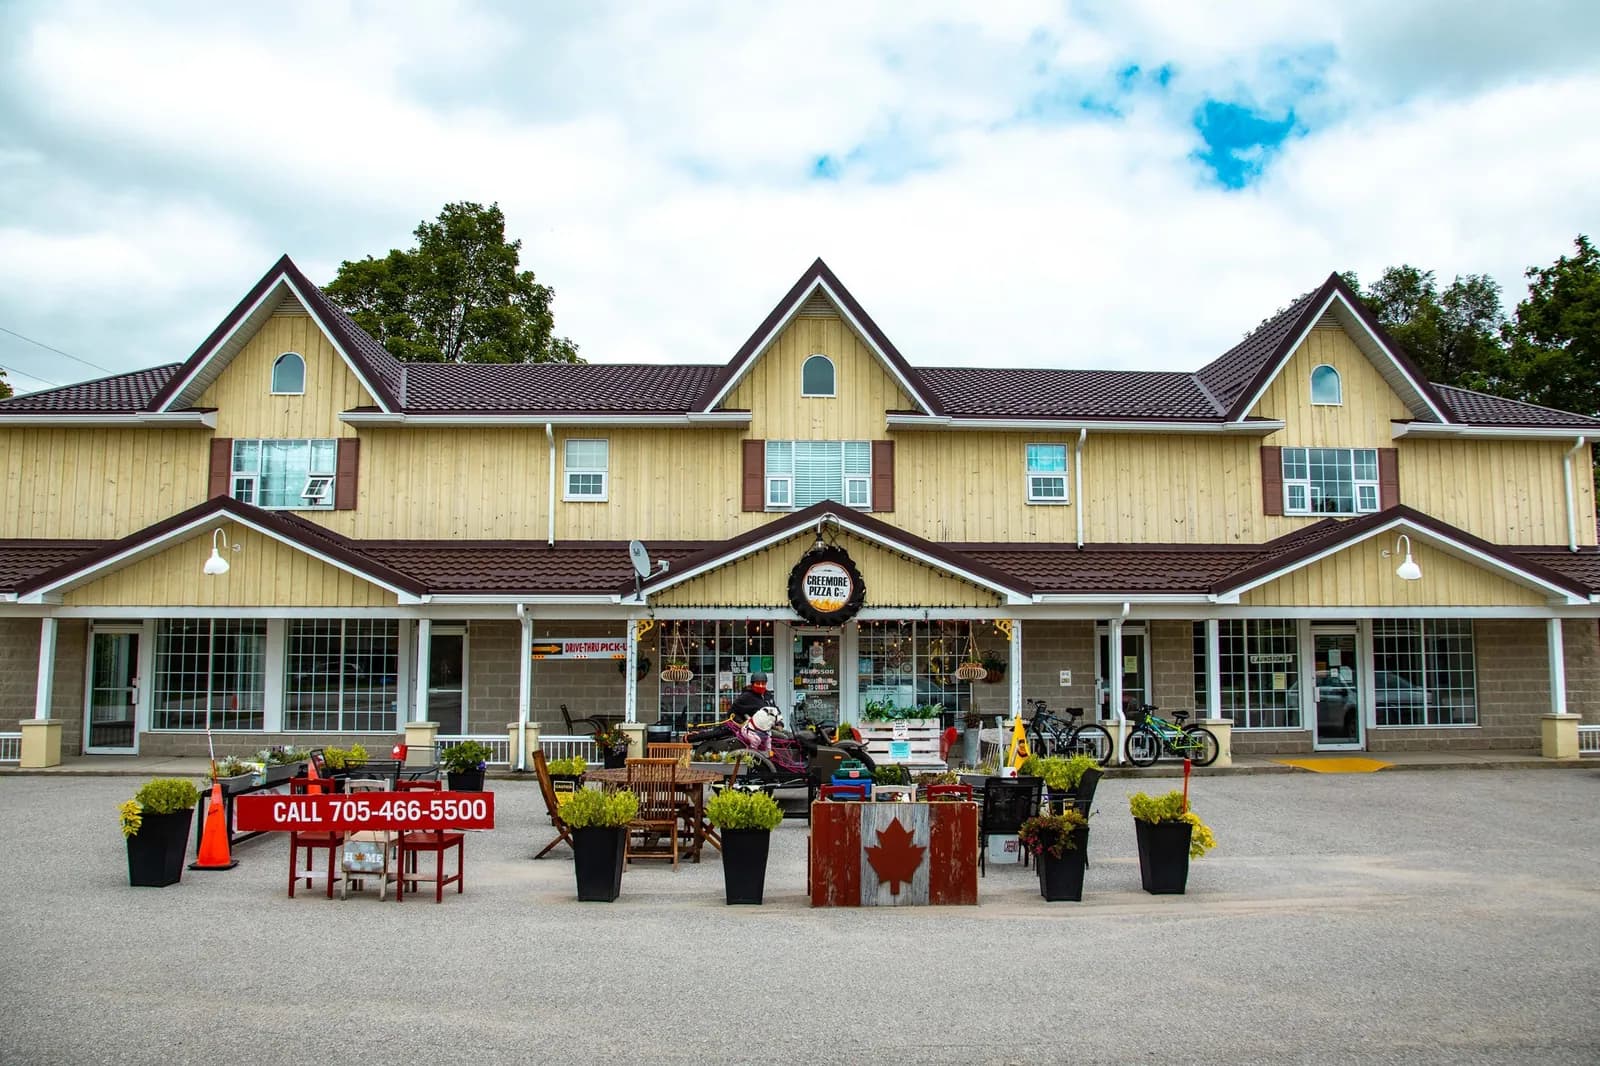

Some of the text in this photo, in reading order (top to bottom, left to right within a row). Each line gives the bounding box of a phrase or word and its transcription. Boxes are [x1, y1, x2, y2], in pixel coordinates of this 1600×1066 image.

[807, 575, 848, 587] CREEMORE
[809, 586, 832, 597] PIZZA
[564, 642, 627, 653] DRIVE-THRU PICK-U
[273, 799, 487, 823] CALL 705-466-5500
